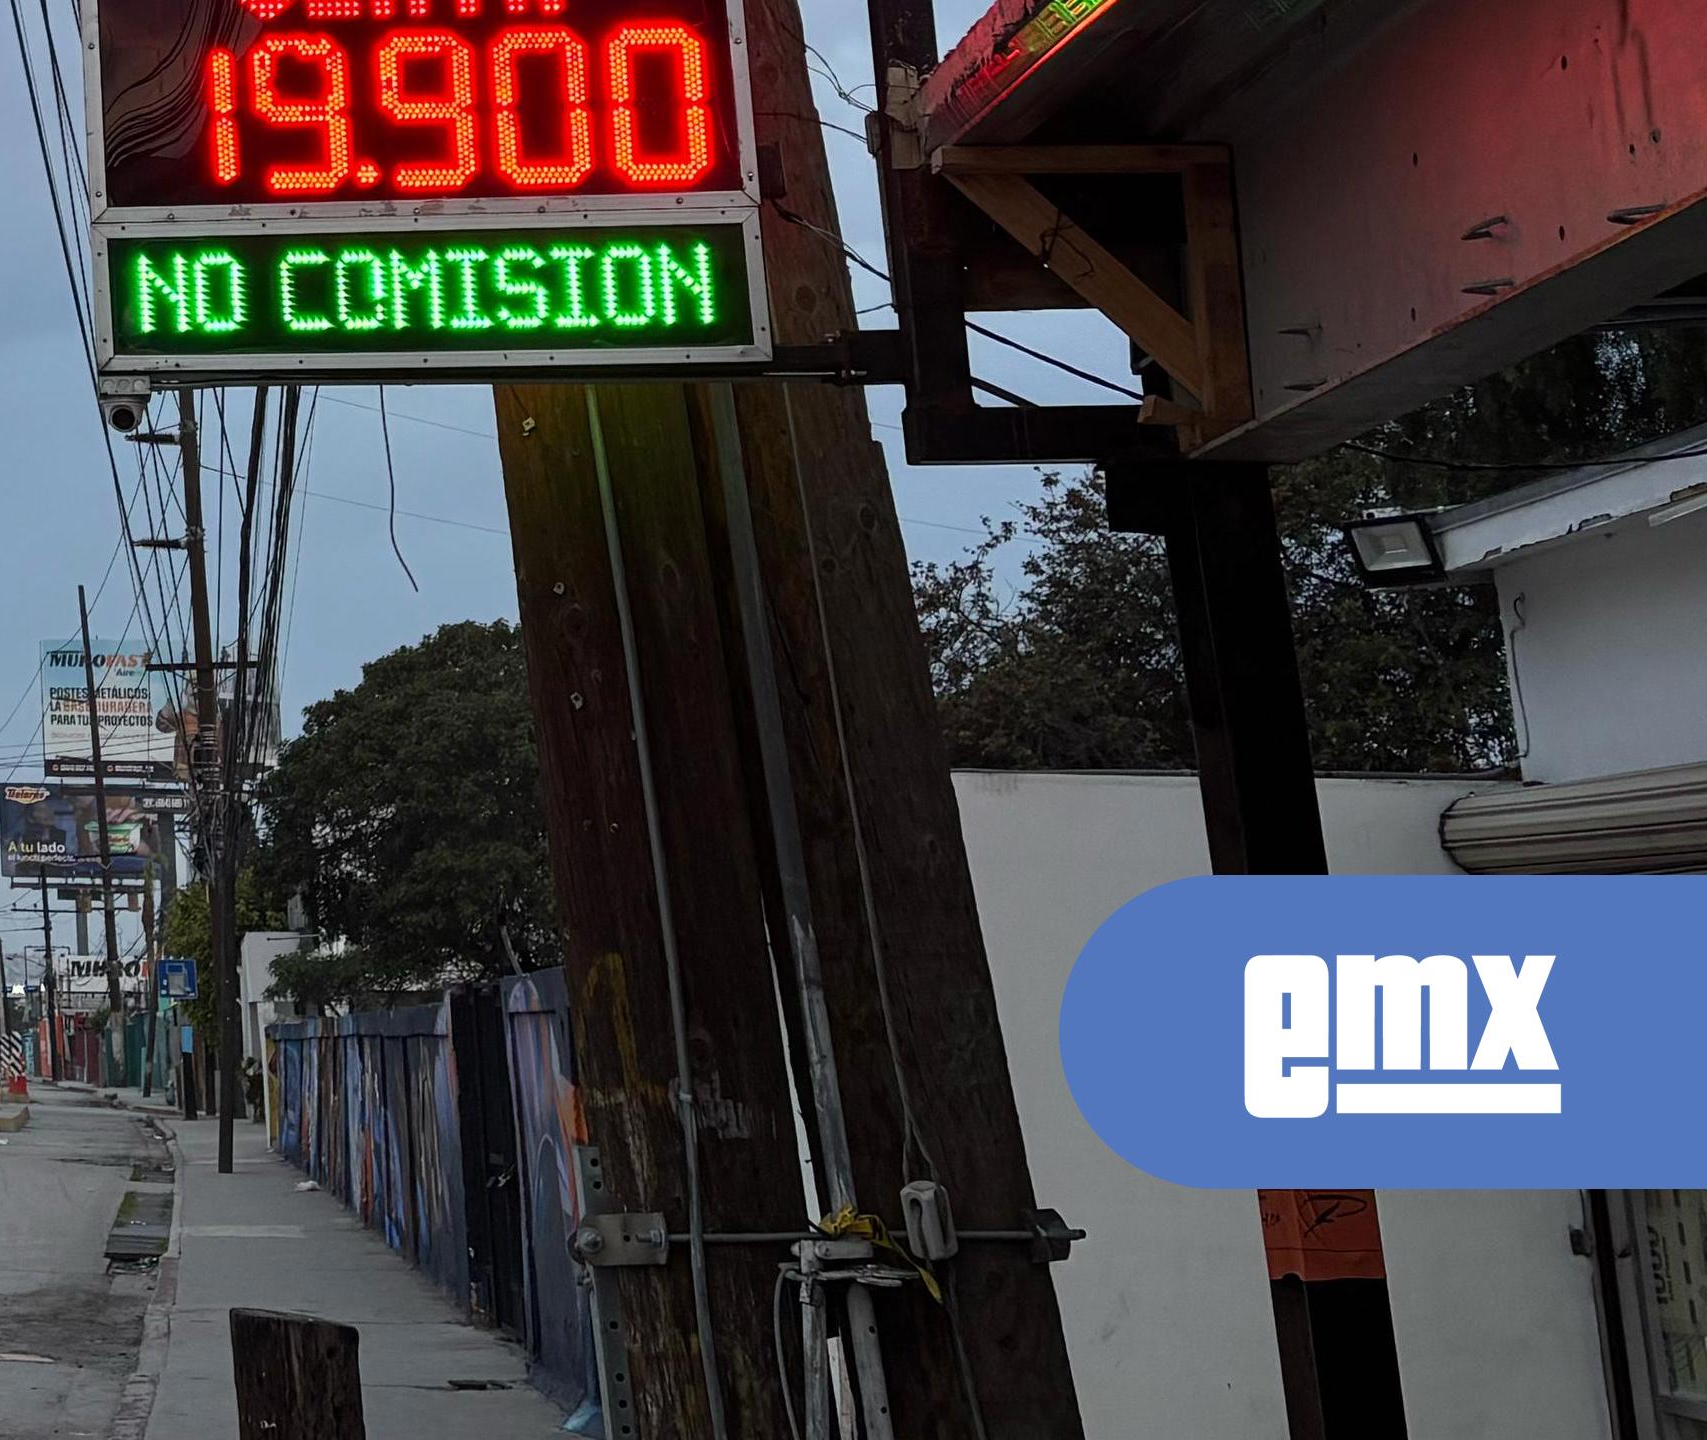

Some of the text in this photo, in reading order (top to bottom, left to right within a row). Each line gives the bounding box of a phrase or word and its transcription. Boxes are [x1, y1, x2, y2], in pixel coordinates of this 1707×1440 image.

[209, 24, 712, 192] 19.900
[137, 242, 716, 333] NO COMISION
[50, 687, 89, 699] POSTES
[50, 701, 61, 712] LA
[51, 714, 154, 727] PARA TU PROYECTOS
[8, 840, 66, 853] A tu lado
